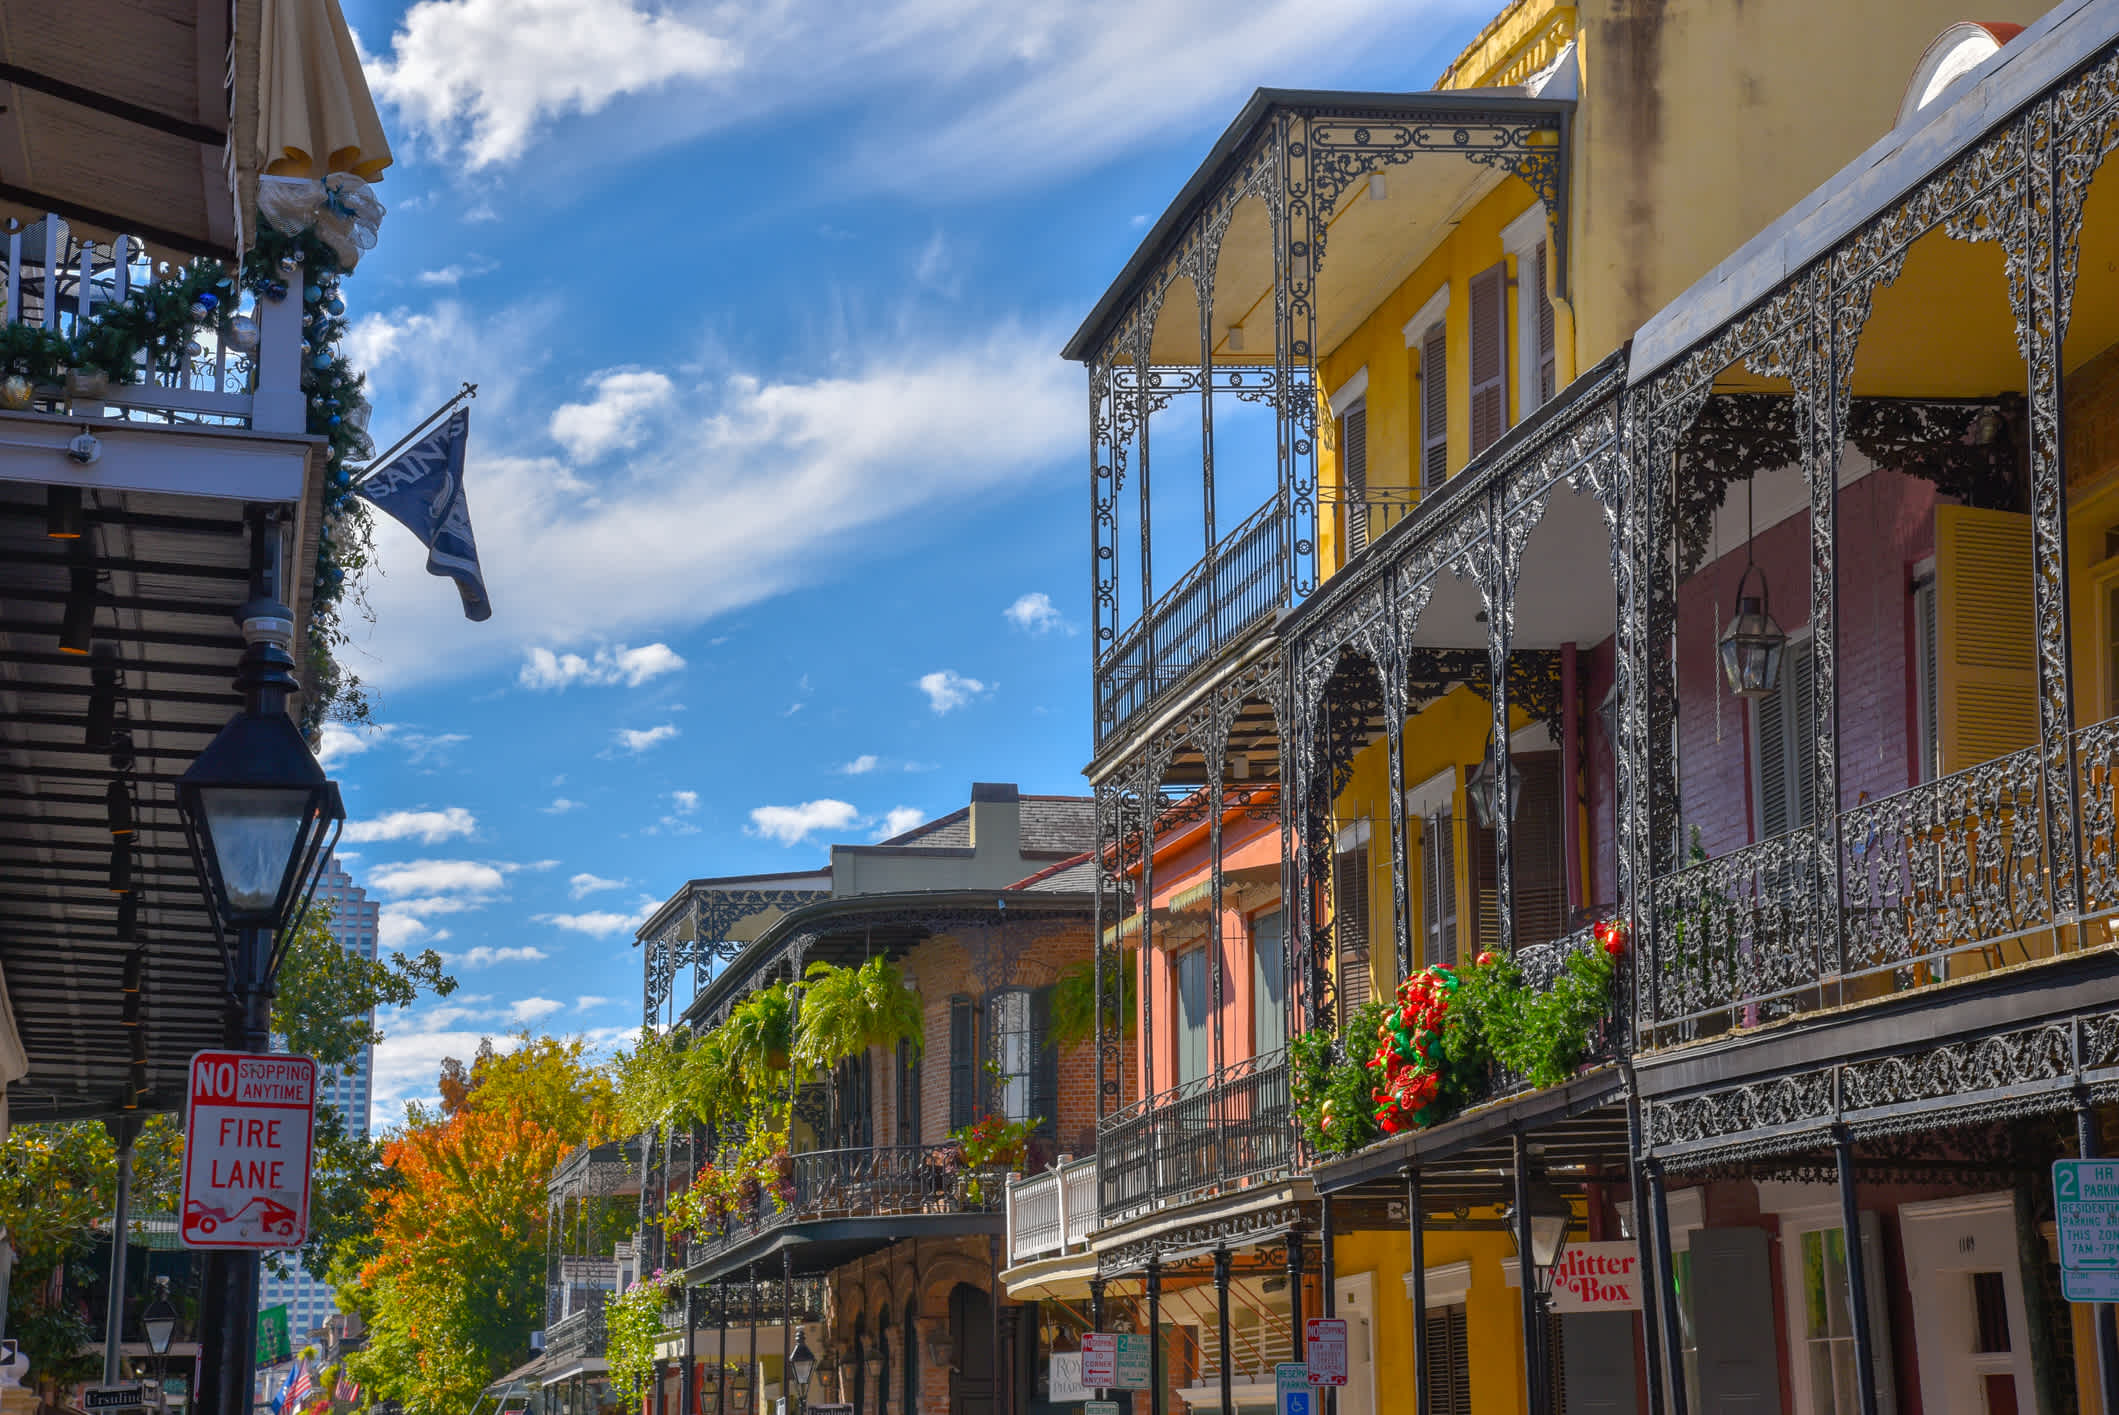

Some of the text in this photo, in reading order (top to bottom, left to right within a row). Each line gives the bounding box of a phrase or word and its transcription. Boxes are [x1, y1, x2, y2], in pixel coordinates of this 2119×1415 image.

[195, 1061, 311, 1098] NO STOPPING
[243, 1083, 305, 1101] ANYTIME
[219, 1118, 283, 1149] FIRE
[210, 1159, 285, 1190] LANE
[2059, 1169, 2076, 1197] 2
[2094, 1167, 2114, 1181] HR
[2083, 1183, 2119, 1199] PARKIN
[2062, 1203, 2119, 1214] RESIDENTIA
[2063, 1216, 2119, 1227] PARKING AR
[2067, 1230, 2119, 1242] THIS ZON
[1549, 1249, 1636, 1287] Glitter
[1568, 1277, 1632, 1303] Box
[1308, 1325, 1319, 1337] NO
[1119, 1337, 1127, 1350] 2
[1056, 1357, 1080, 1379] ROY
